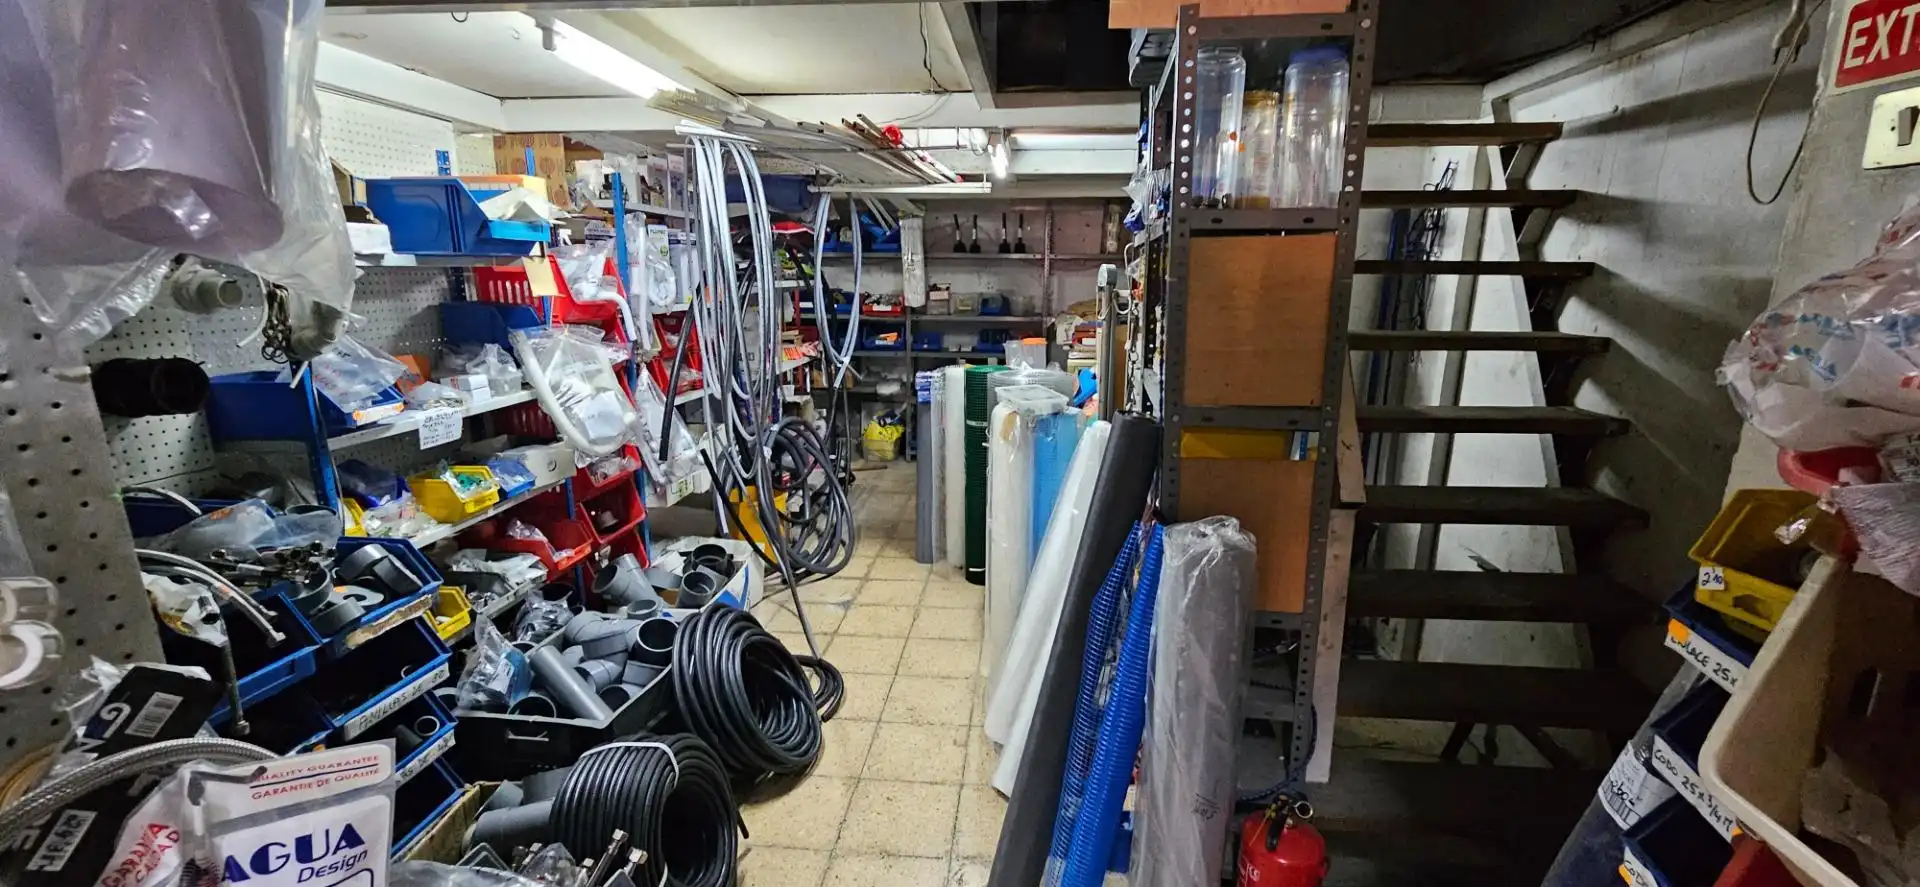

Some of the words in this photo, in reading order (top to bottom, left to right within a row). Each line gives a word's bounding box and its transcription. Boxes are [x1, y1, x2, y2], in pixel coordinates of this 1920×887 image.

[306, 755, 380, 772] GUARANTEE
[1654, 749, 1679, 776] CODO
[251, 782, 313, 800] GARANTIE
[316, 779, 329, 788] DE
[221, 823, 366, 883] AGUA
[297, 849, 369, 885] Design
